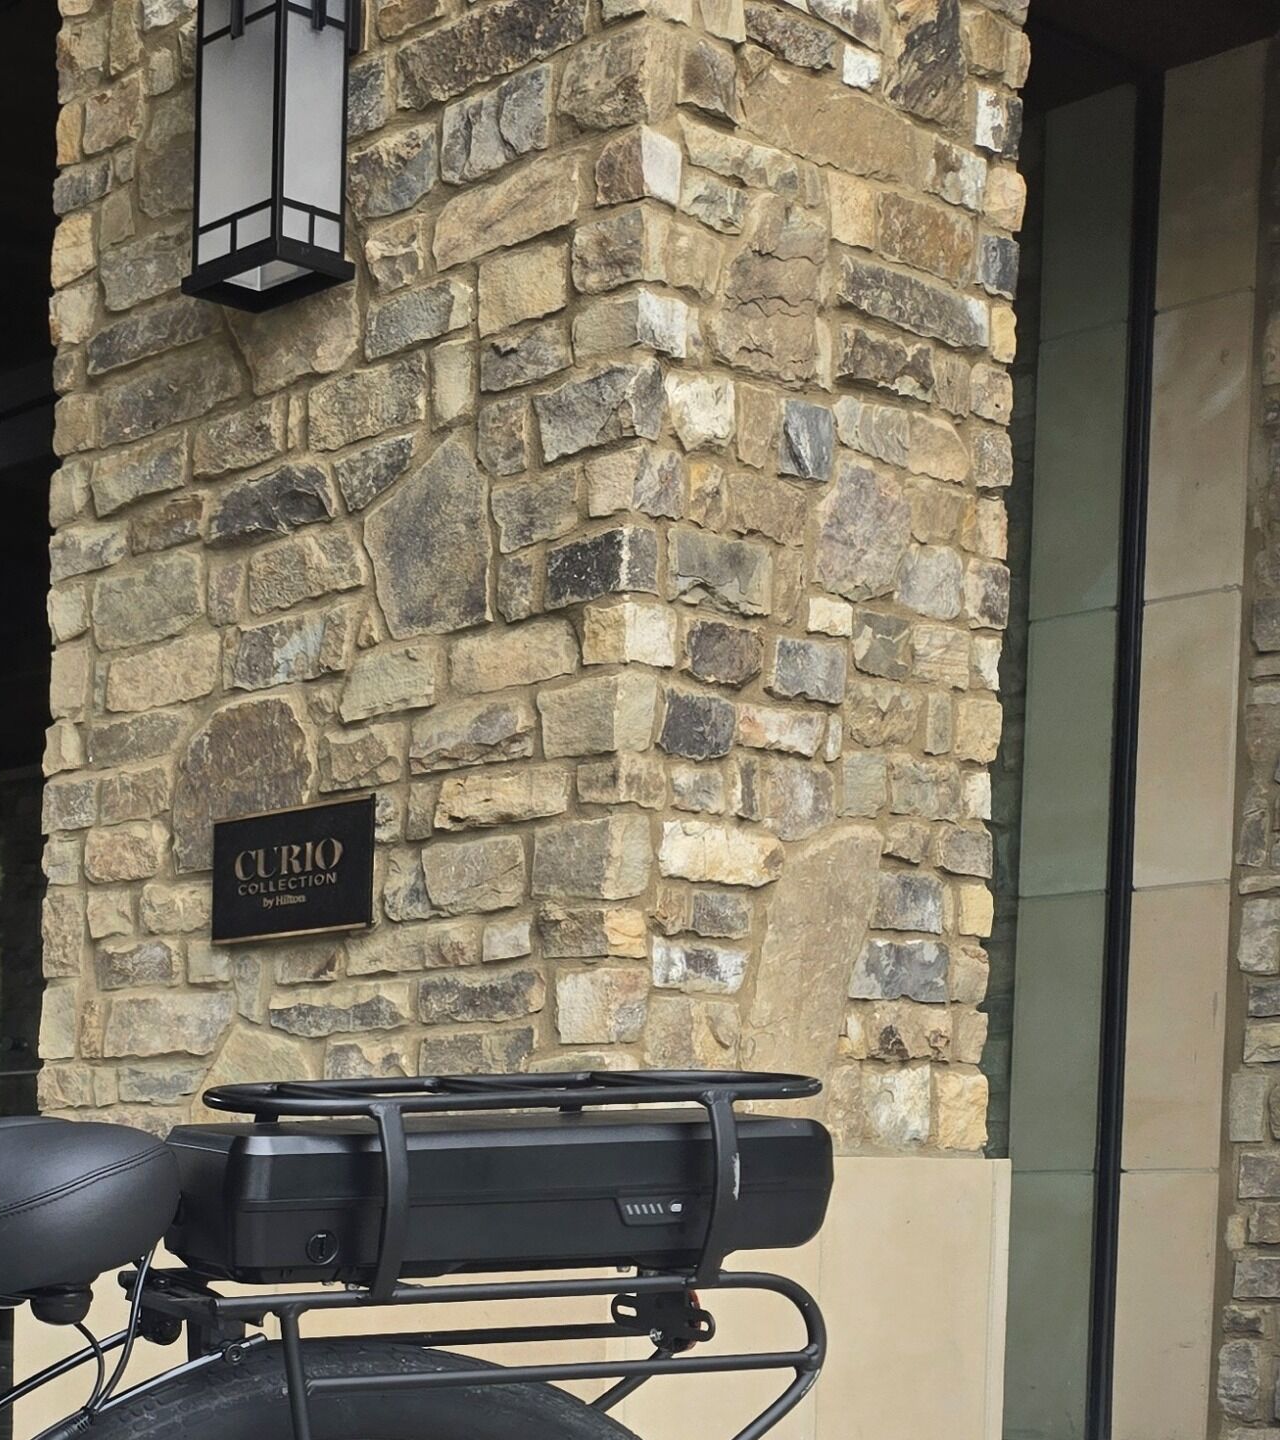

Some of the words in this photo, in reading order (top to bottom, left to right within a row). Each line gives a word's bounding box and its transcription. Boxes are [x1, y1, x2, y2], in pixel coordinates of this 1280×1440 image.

[234, 838, 344, 881] CURIO
[238, 872, 337, 896] COLLECTION
[262, 896, 275, 909] by
[275, 895, 307, 906] Hilton
